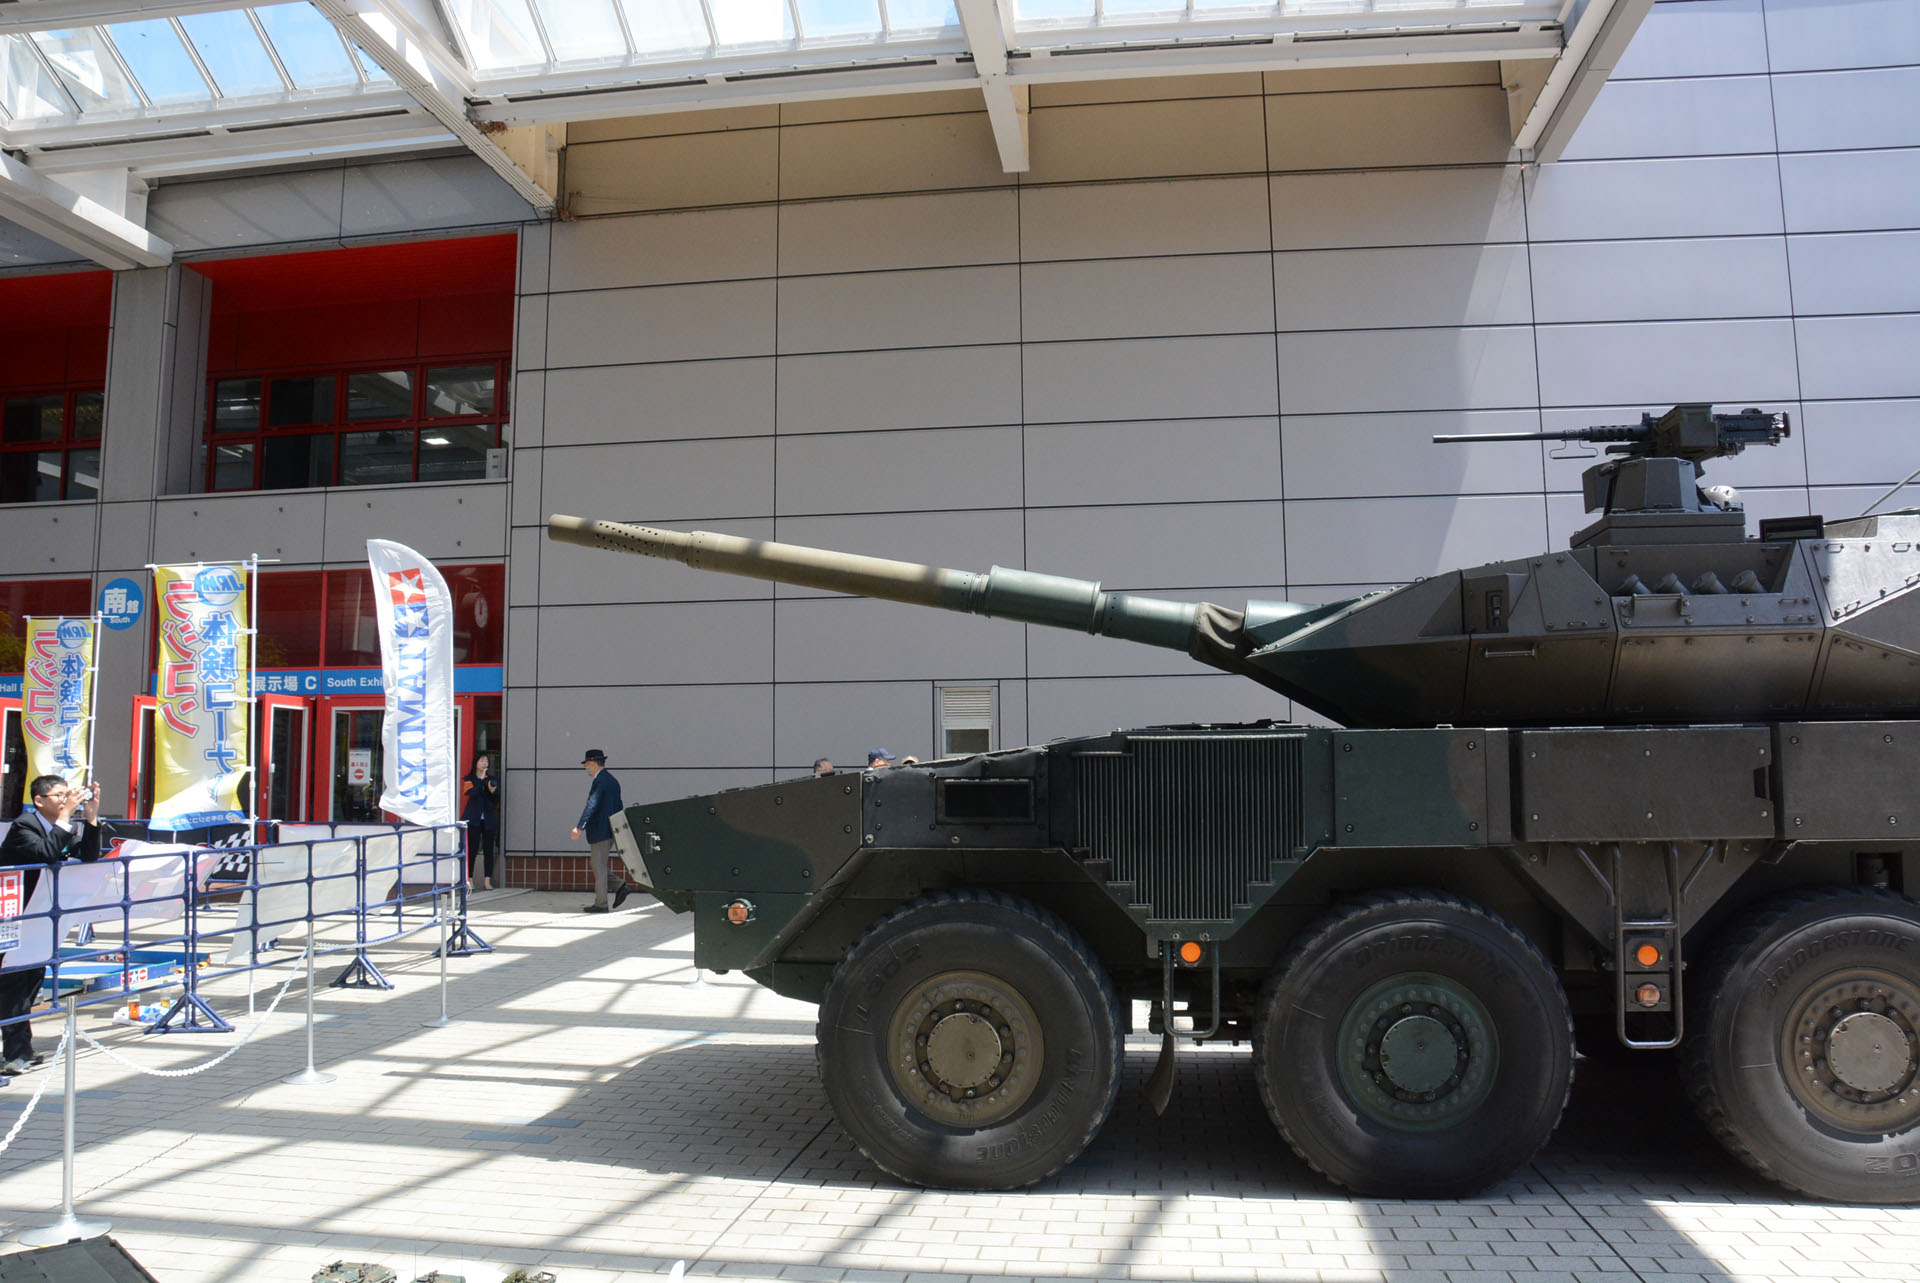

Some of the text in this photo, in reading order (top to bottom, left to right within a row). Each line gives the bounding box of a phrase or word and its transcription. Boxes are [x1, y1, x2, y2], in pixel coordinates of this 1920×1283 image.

[104, 587, 139, 614] 南館
[109, 616, 131, 624] South
[247, 675, 318, 692] 展示場 C
[327, 676, 383, 688] South Exhi
[1763, 928, 1914, 1002] BRIDGESTONE
